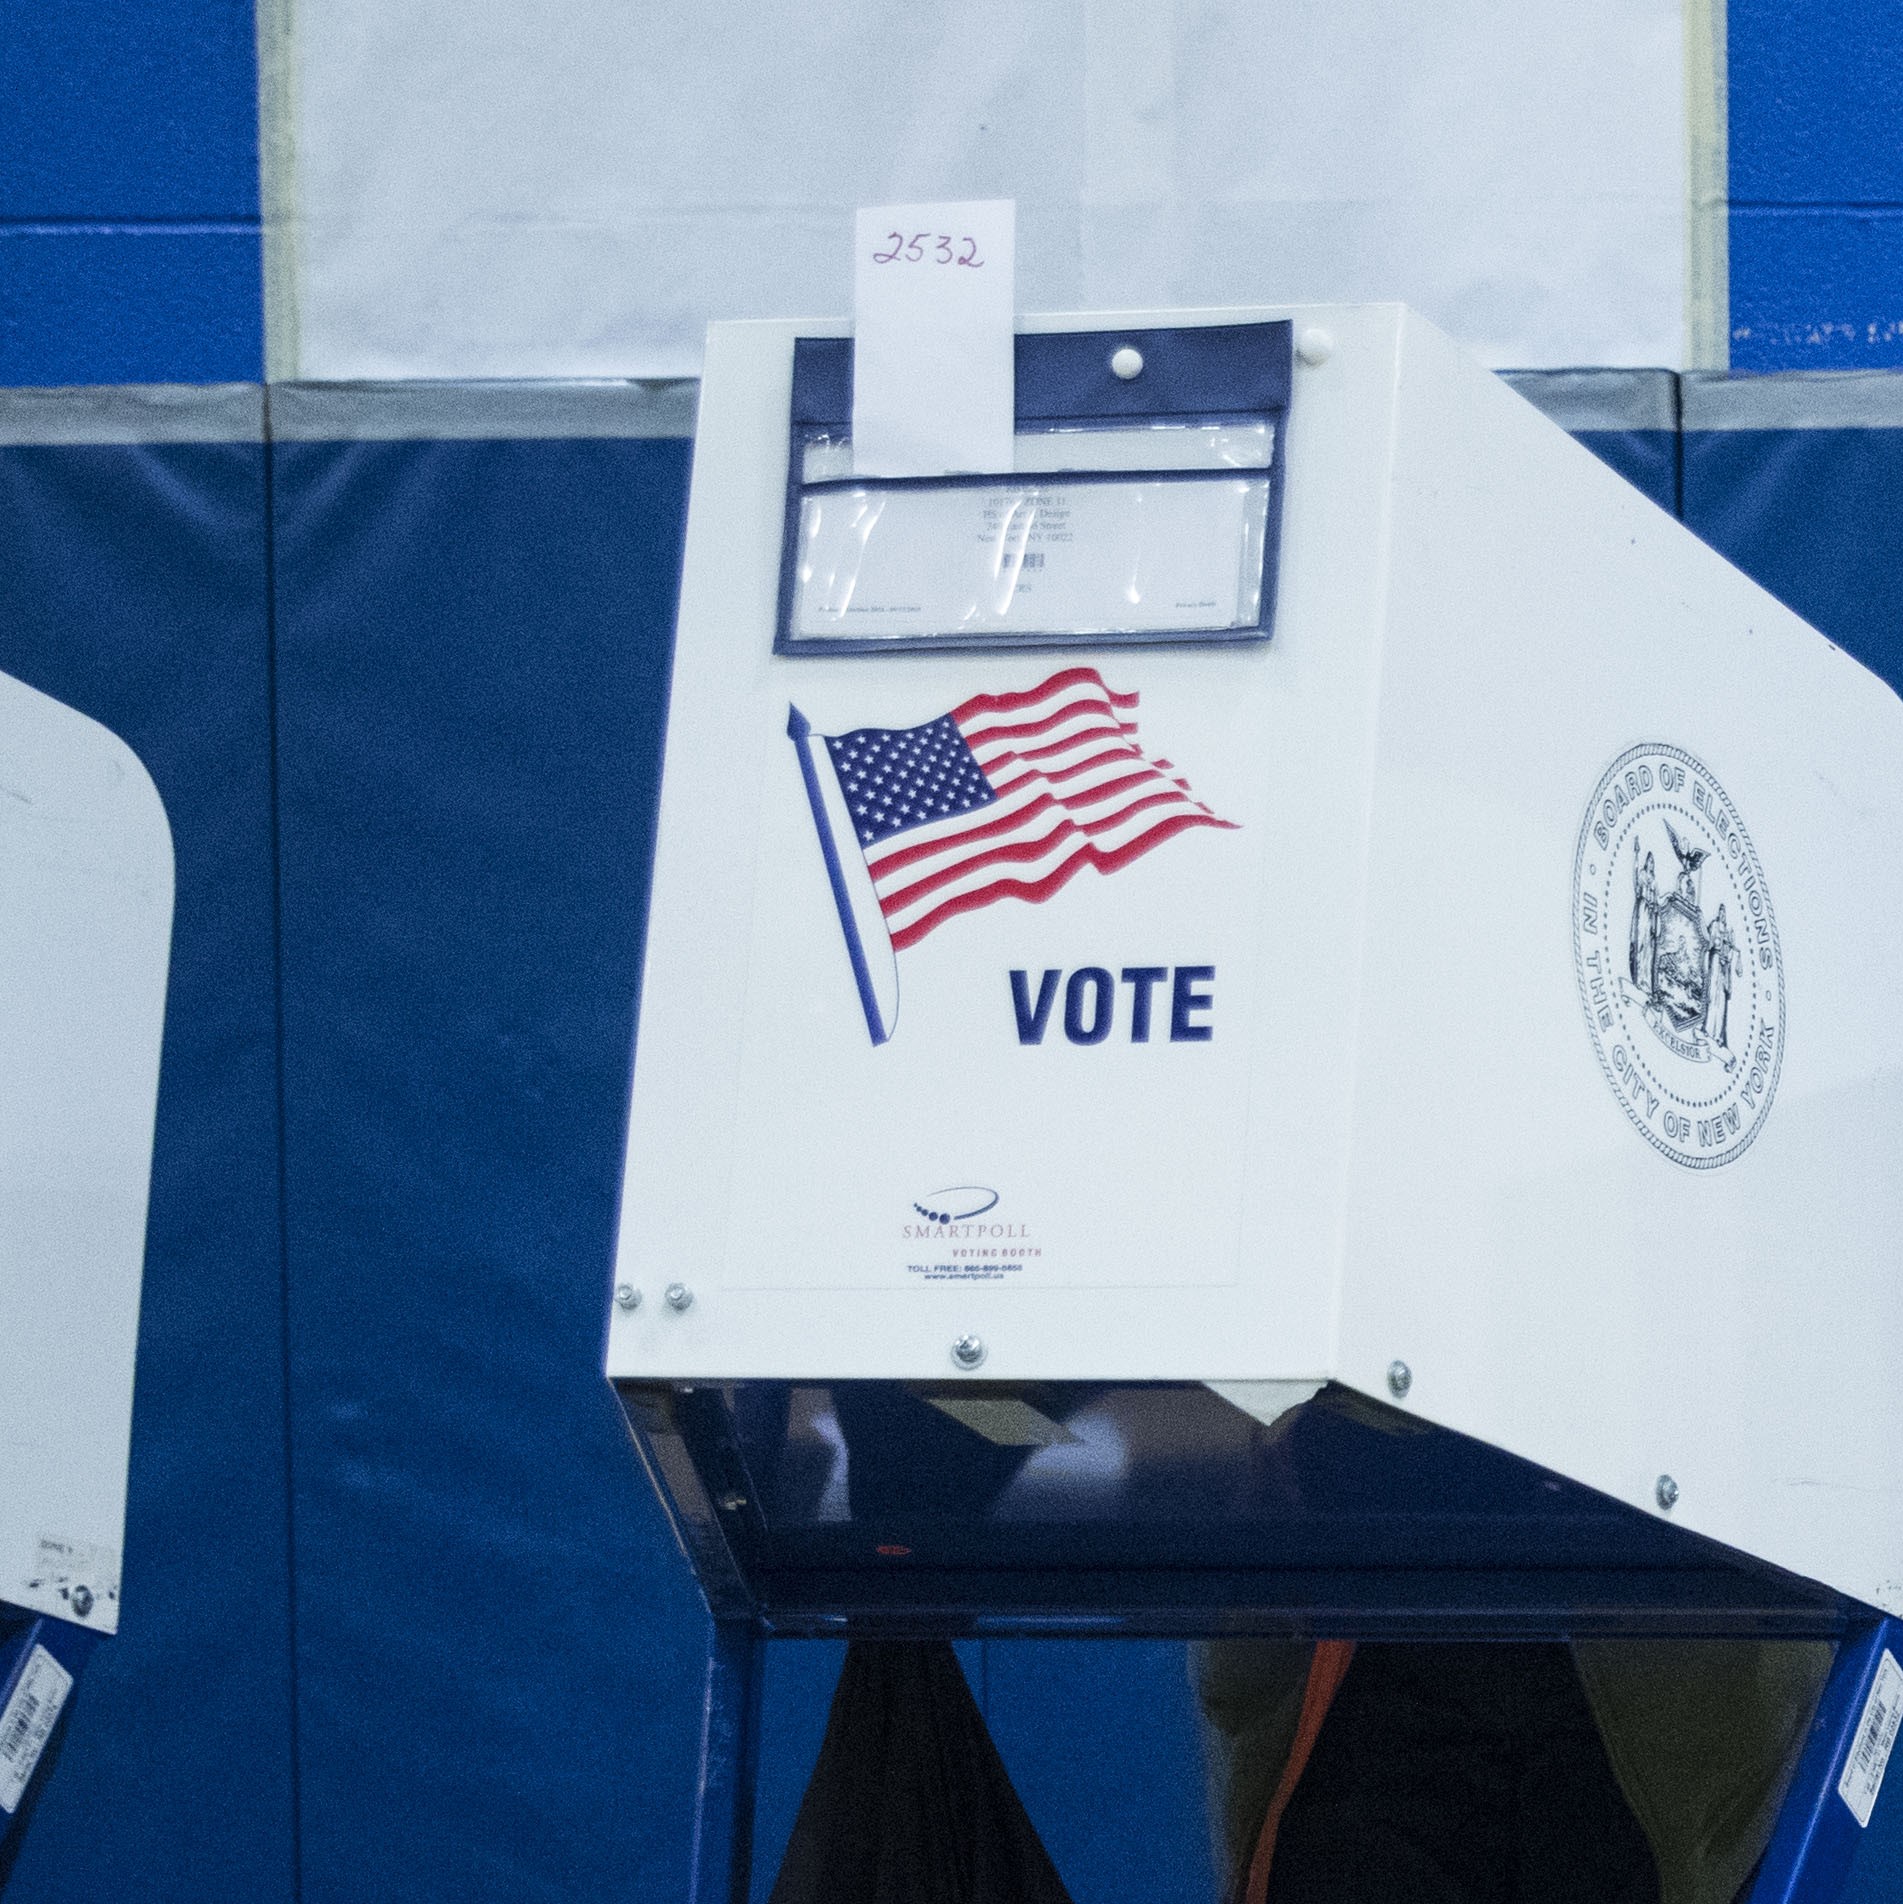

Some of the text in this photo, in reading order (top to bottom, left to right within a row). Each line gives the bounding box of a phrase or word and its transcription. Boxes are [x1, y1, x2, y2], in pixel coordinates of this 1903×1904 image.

[873, 231, 985, 268] 2532
[1594, 762, 1772, 970] BOARD OF ELECTIONS
[1009, 965, 1216, 1046] VOTE
[1583, 891, 1776, 1147] IN THE CITY OF NEW YORK
[902, 1224, 1031, 1239] SMARTPOLL
[952, 1248, 1042, 1258] VOTING BOOTH
